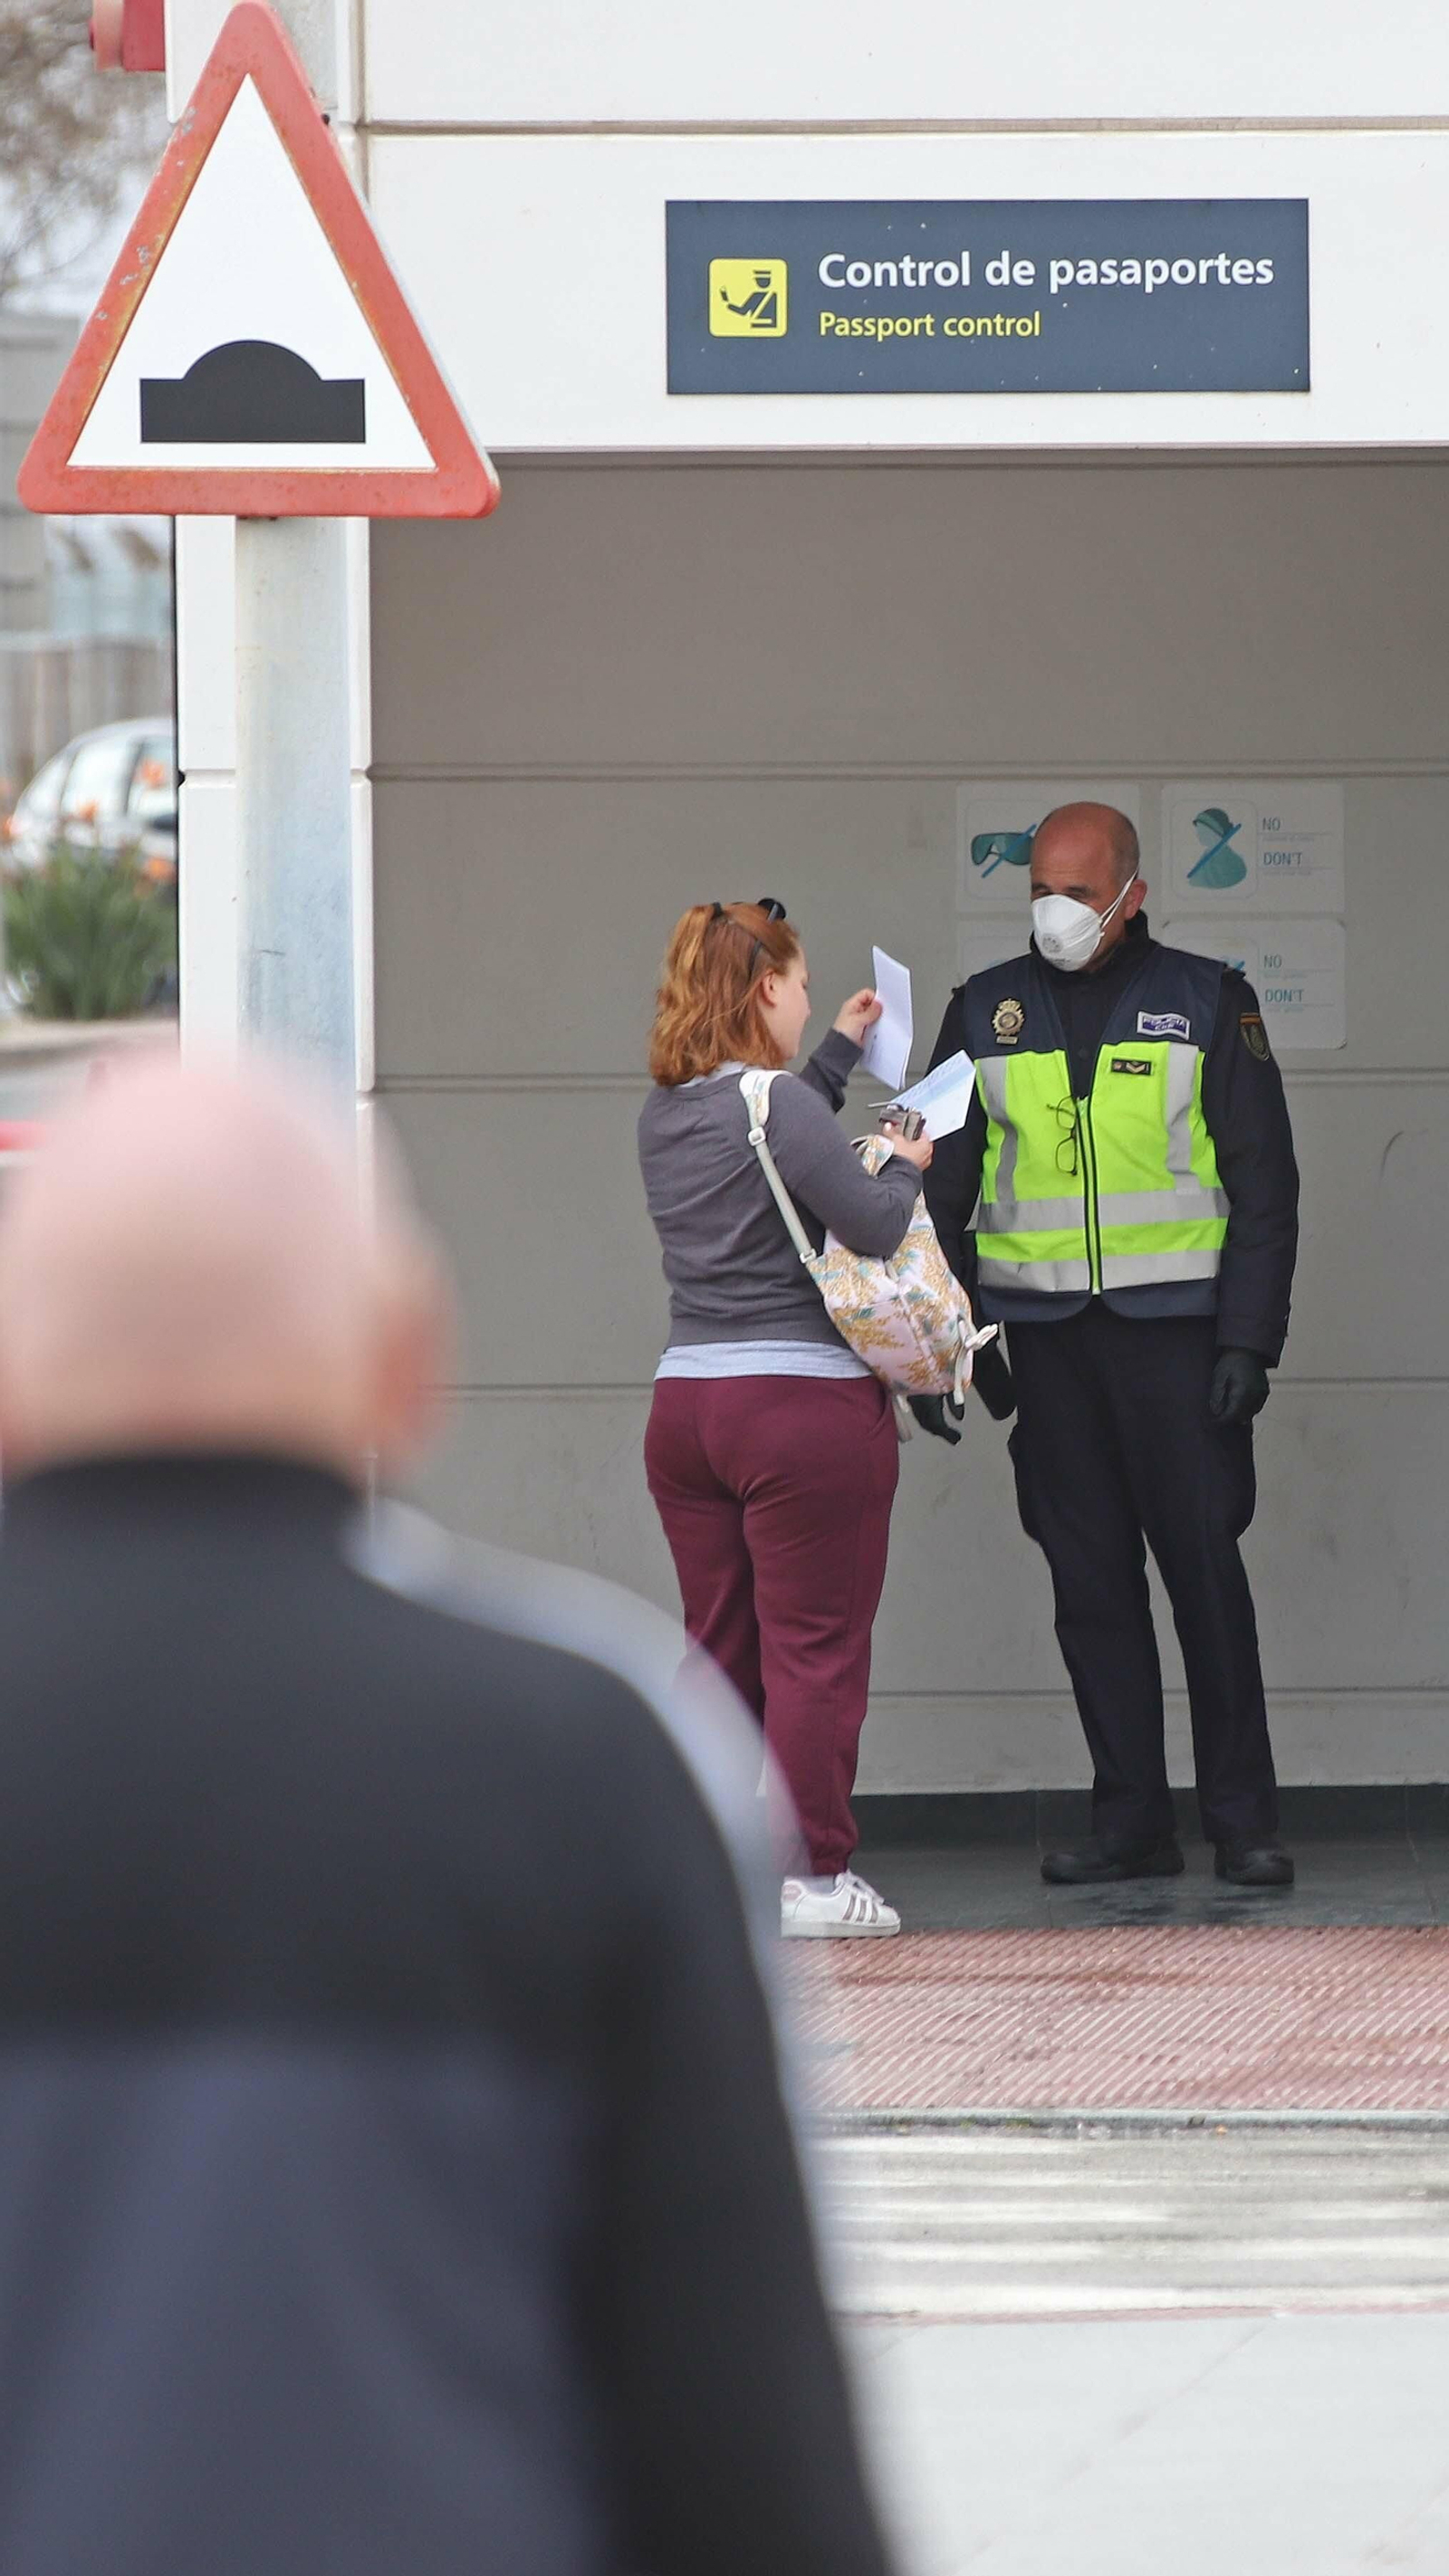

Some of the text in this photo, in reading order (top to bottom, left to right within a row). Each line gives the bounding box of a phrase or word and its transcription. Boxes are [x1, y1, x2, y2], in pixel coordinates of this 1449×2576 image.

[819, 251, 1273, 293] Control de pasaportes
[820, 311, 1040, 342] Passport control
[1262, 817, 1281, 831] NO
[1263, 852, 1302, 866] DON'T
[1264, 954, 1281, 968] NO
[1265, 989, 1304, 1002] DON'T
